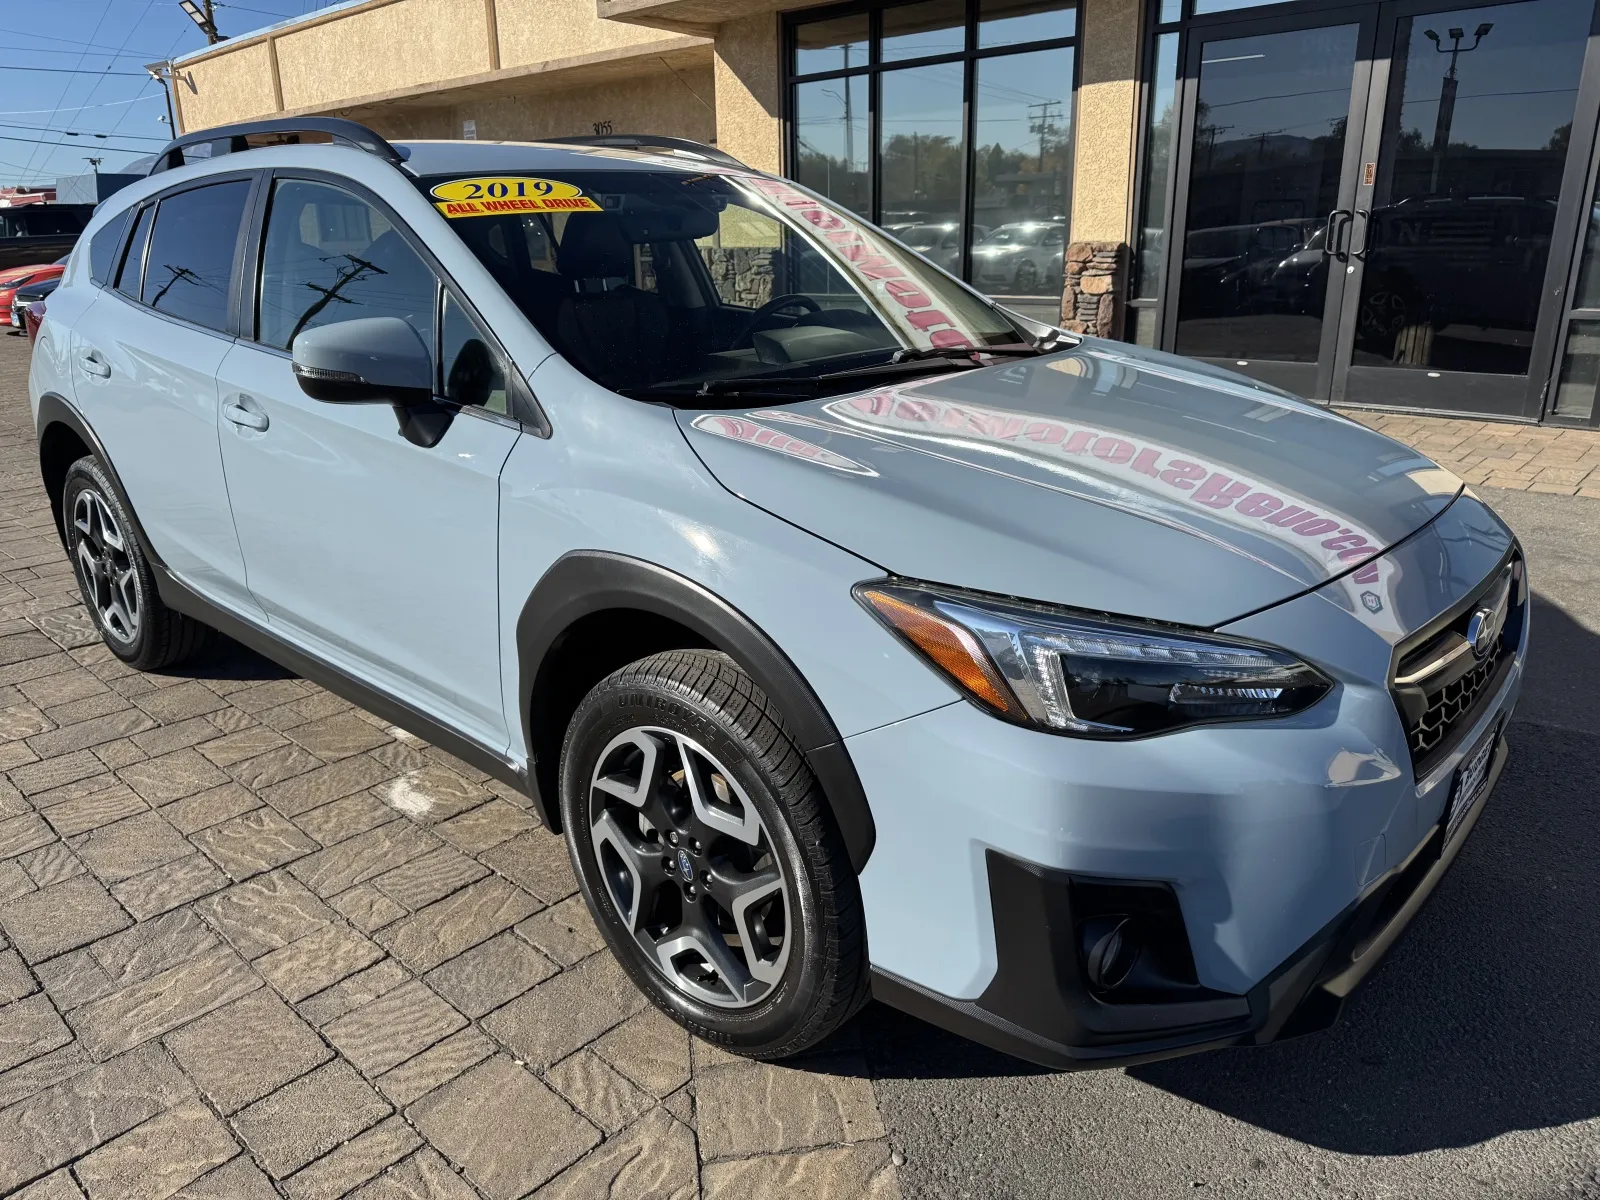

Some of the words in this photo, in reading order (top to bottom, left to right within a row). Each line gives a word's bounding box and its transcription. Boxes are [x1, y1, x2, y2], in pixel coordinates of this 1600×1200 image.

[462, 181, 553, 200] 2019
[447, 201, 484, 215] ALL
[480, 199, 541, 212] WHEEL
[541, 198, 593, 210] DRIVE
[618, 692, 716, 741] UNIROYAL
